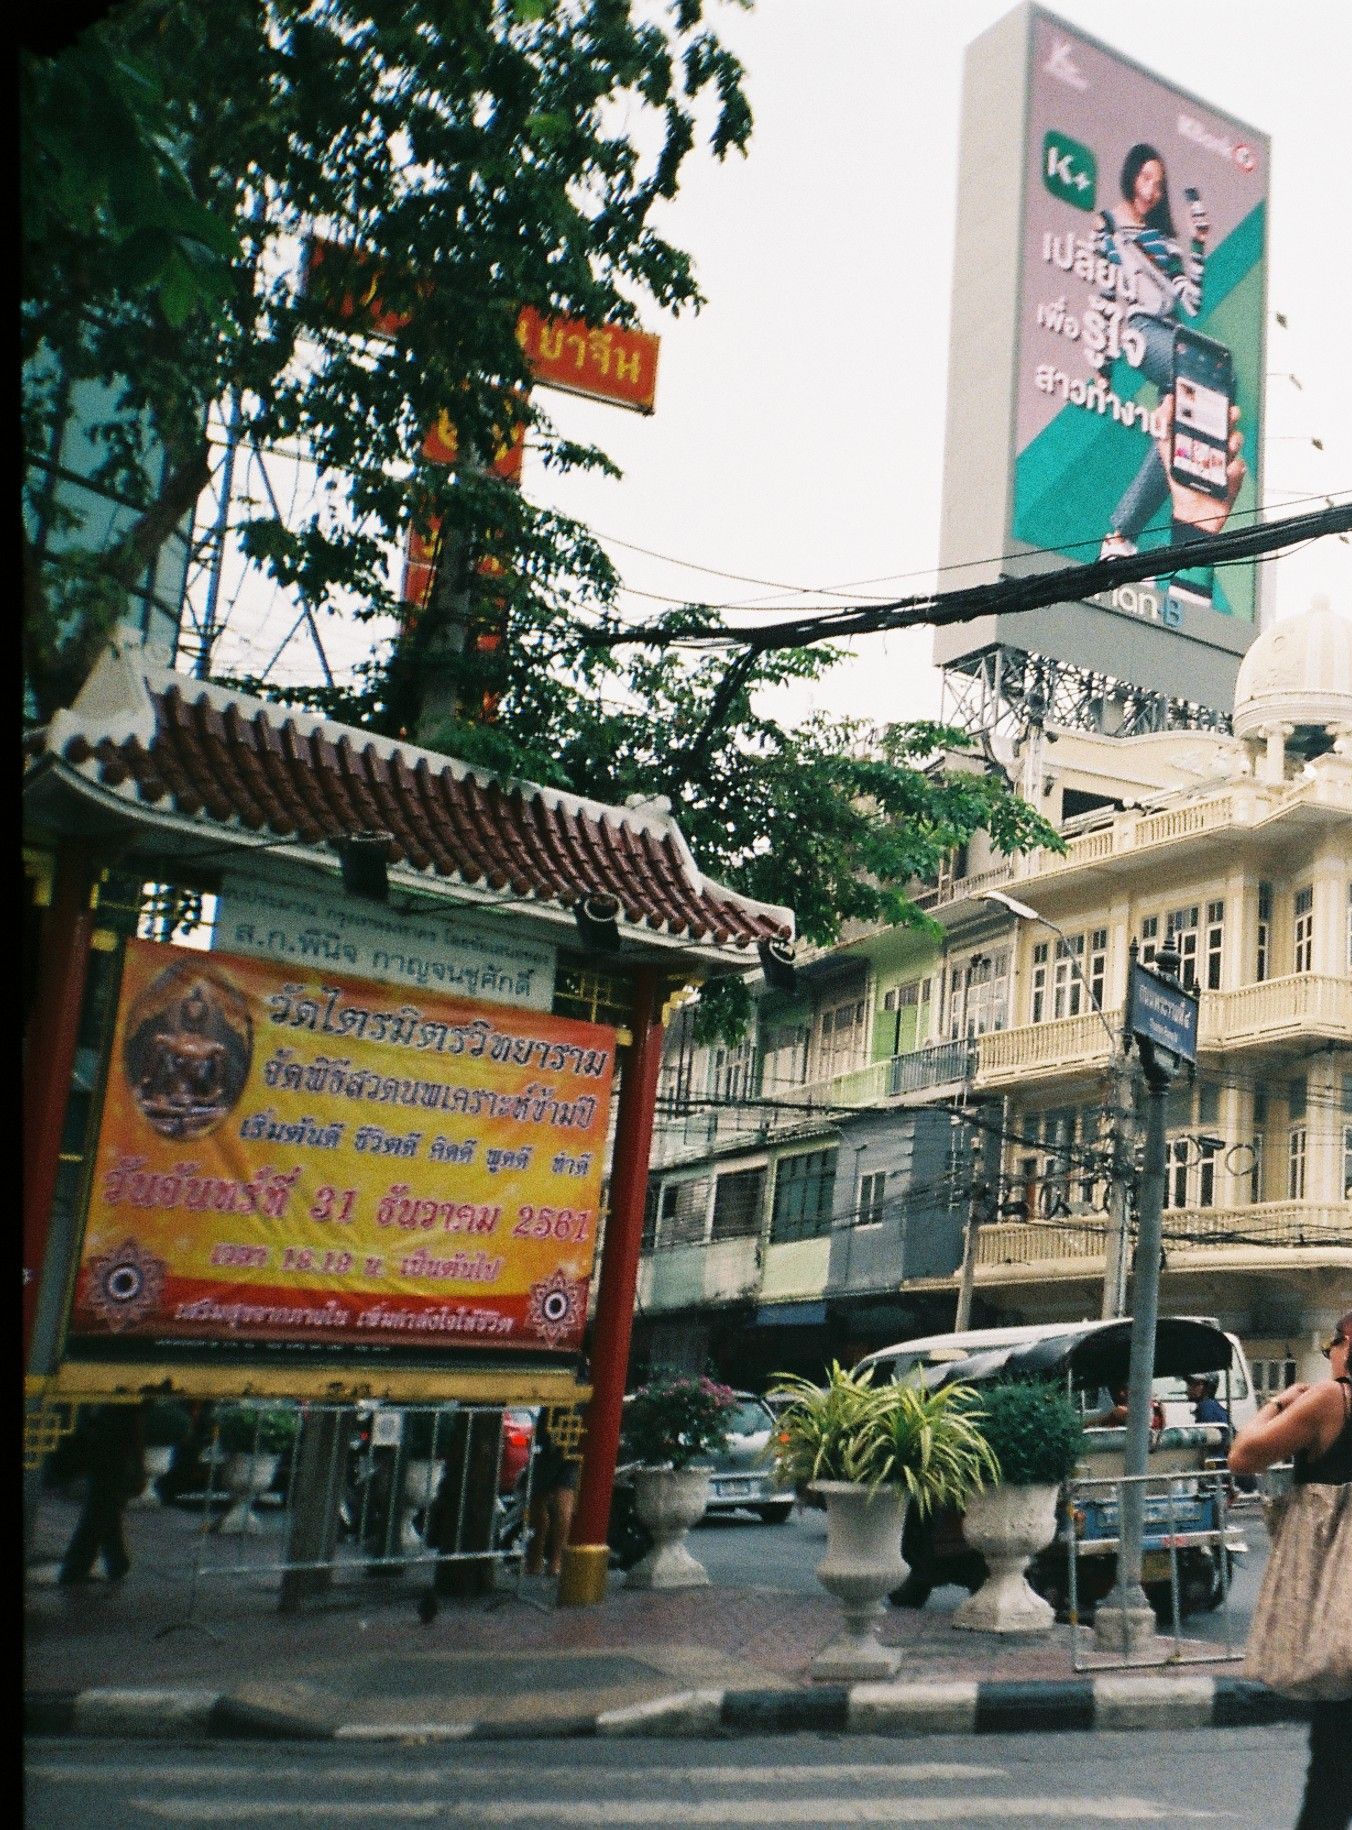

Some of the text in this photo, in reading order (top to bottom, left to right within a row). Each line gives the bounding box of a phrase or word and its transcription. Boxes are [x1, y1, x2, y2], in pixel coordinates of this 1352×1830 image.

[1047, 146, 1090, 191] K+
[1042, 231, 1138, 301] เปลี่ยน
[1035, 364, 1168, 439] สาวทำงาน
[268, 981, 609, 1078] วัดไตรมิตรวิทยาราม
[262, 1047, 597, 1131] จัดพิธีสวดนพเคราะห์ข้ามปี
[104, 1156, 592, 1244] วันจันทร์ที่ 31 ธันวาคม 2561
